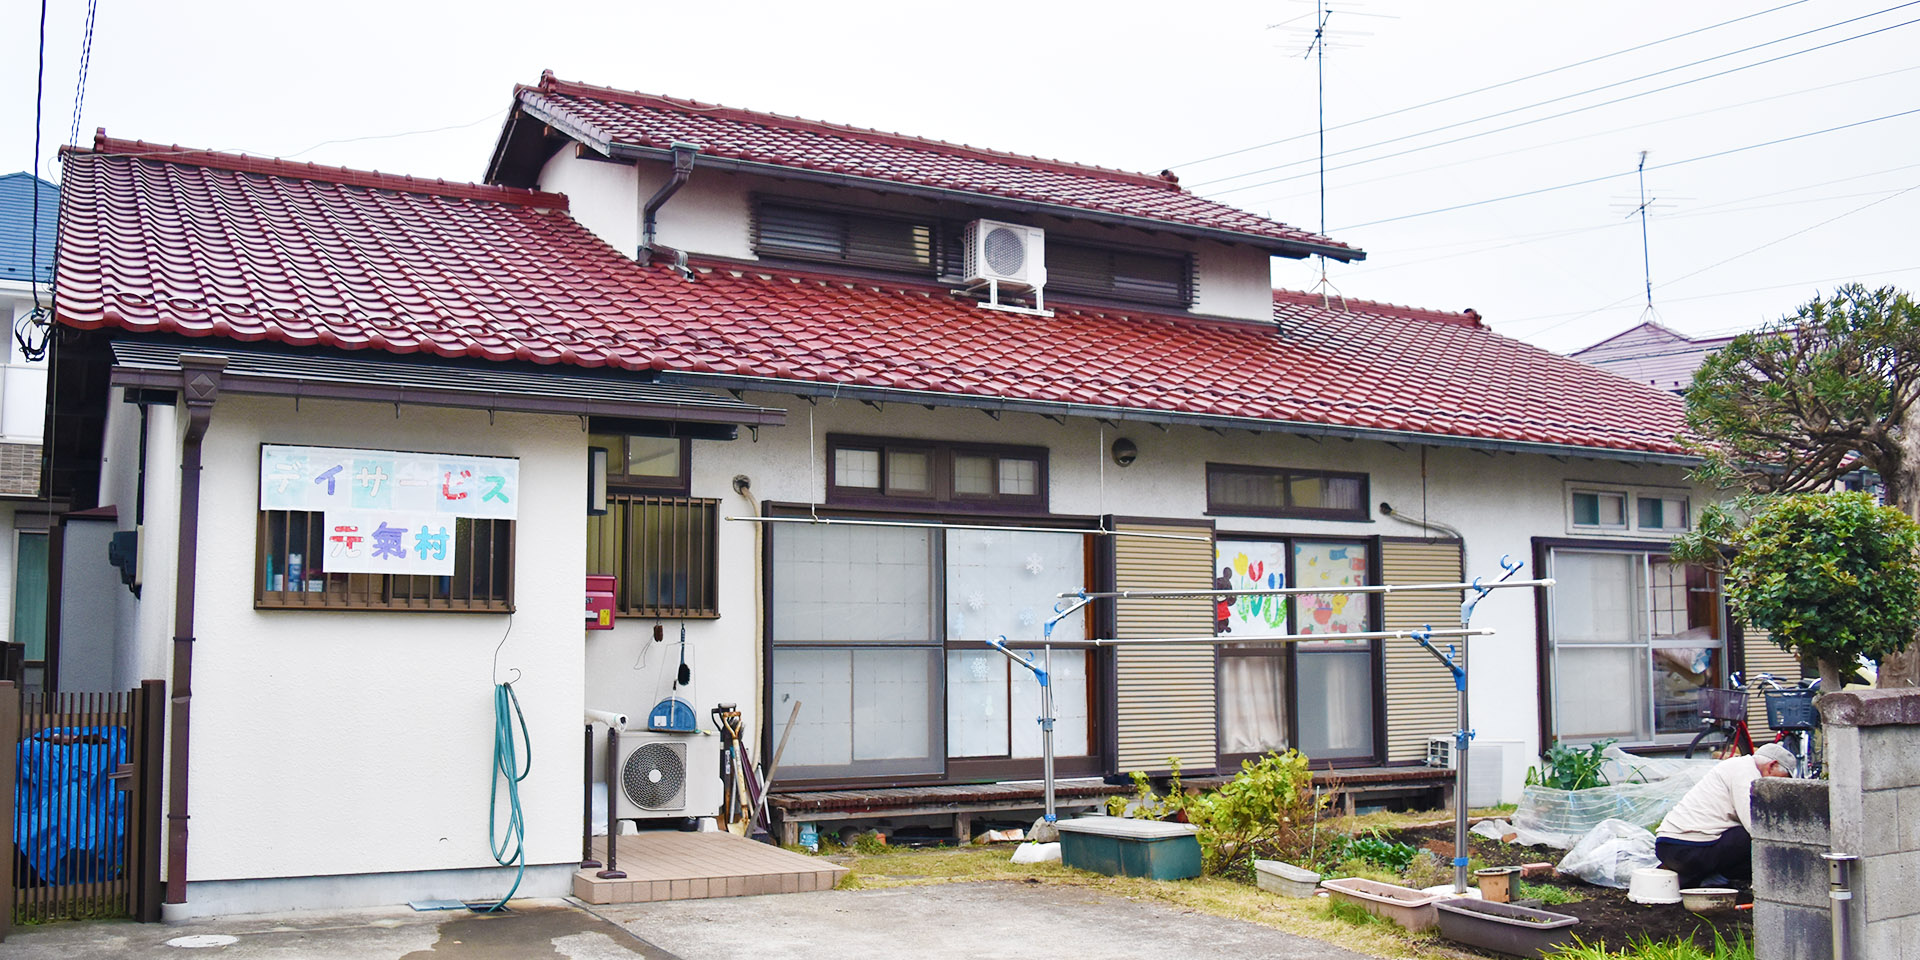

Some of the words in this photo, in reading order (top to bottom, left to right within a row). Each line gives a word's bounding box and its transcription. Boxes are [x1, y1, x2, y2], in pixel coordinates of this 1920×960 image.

[267, 460, 510, 504] デイサービス
[329, 521, 450, 561] 元氣村
